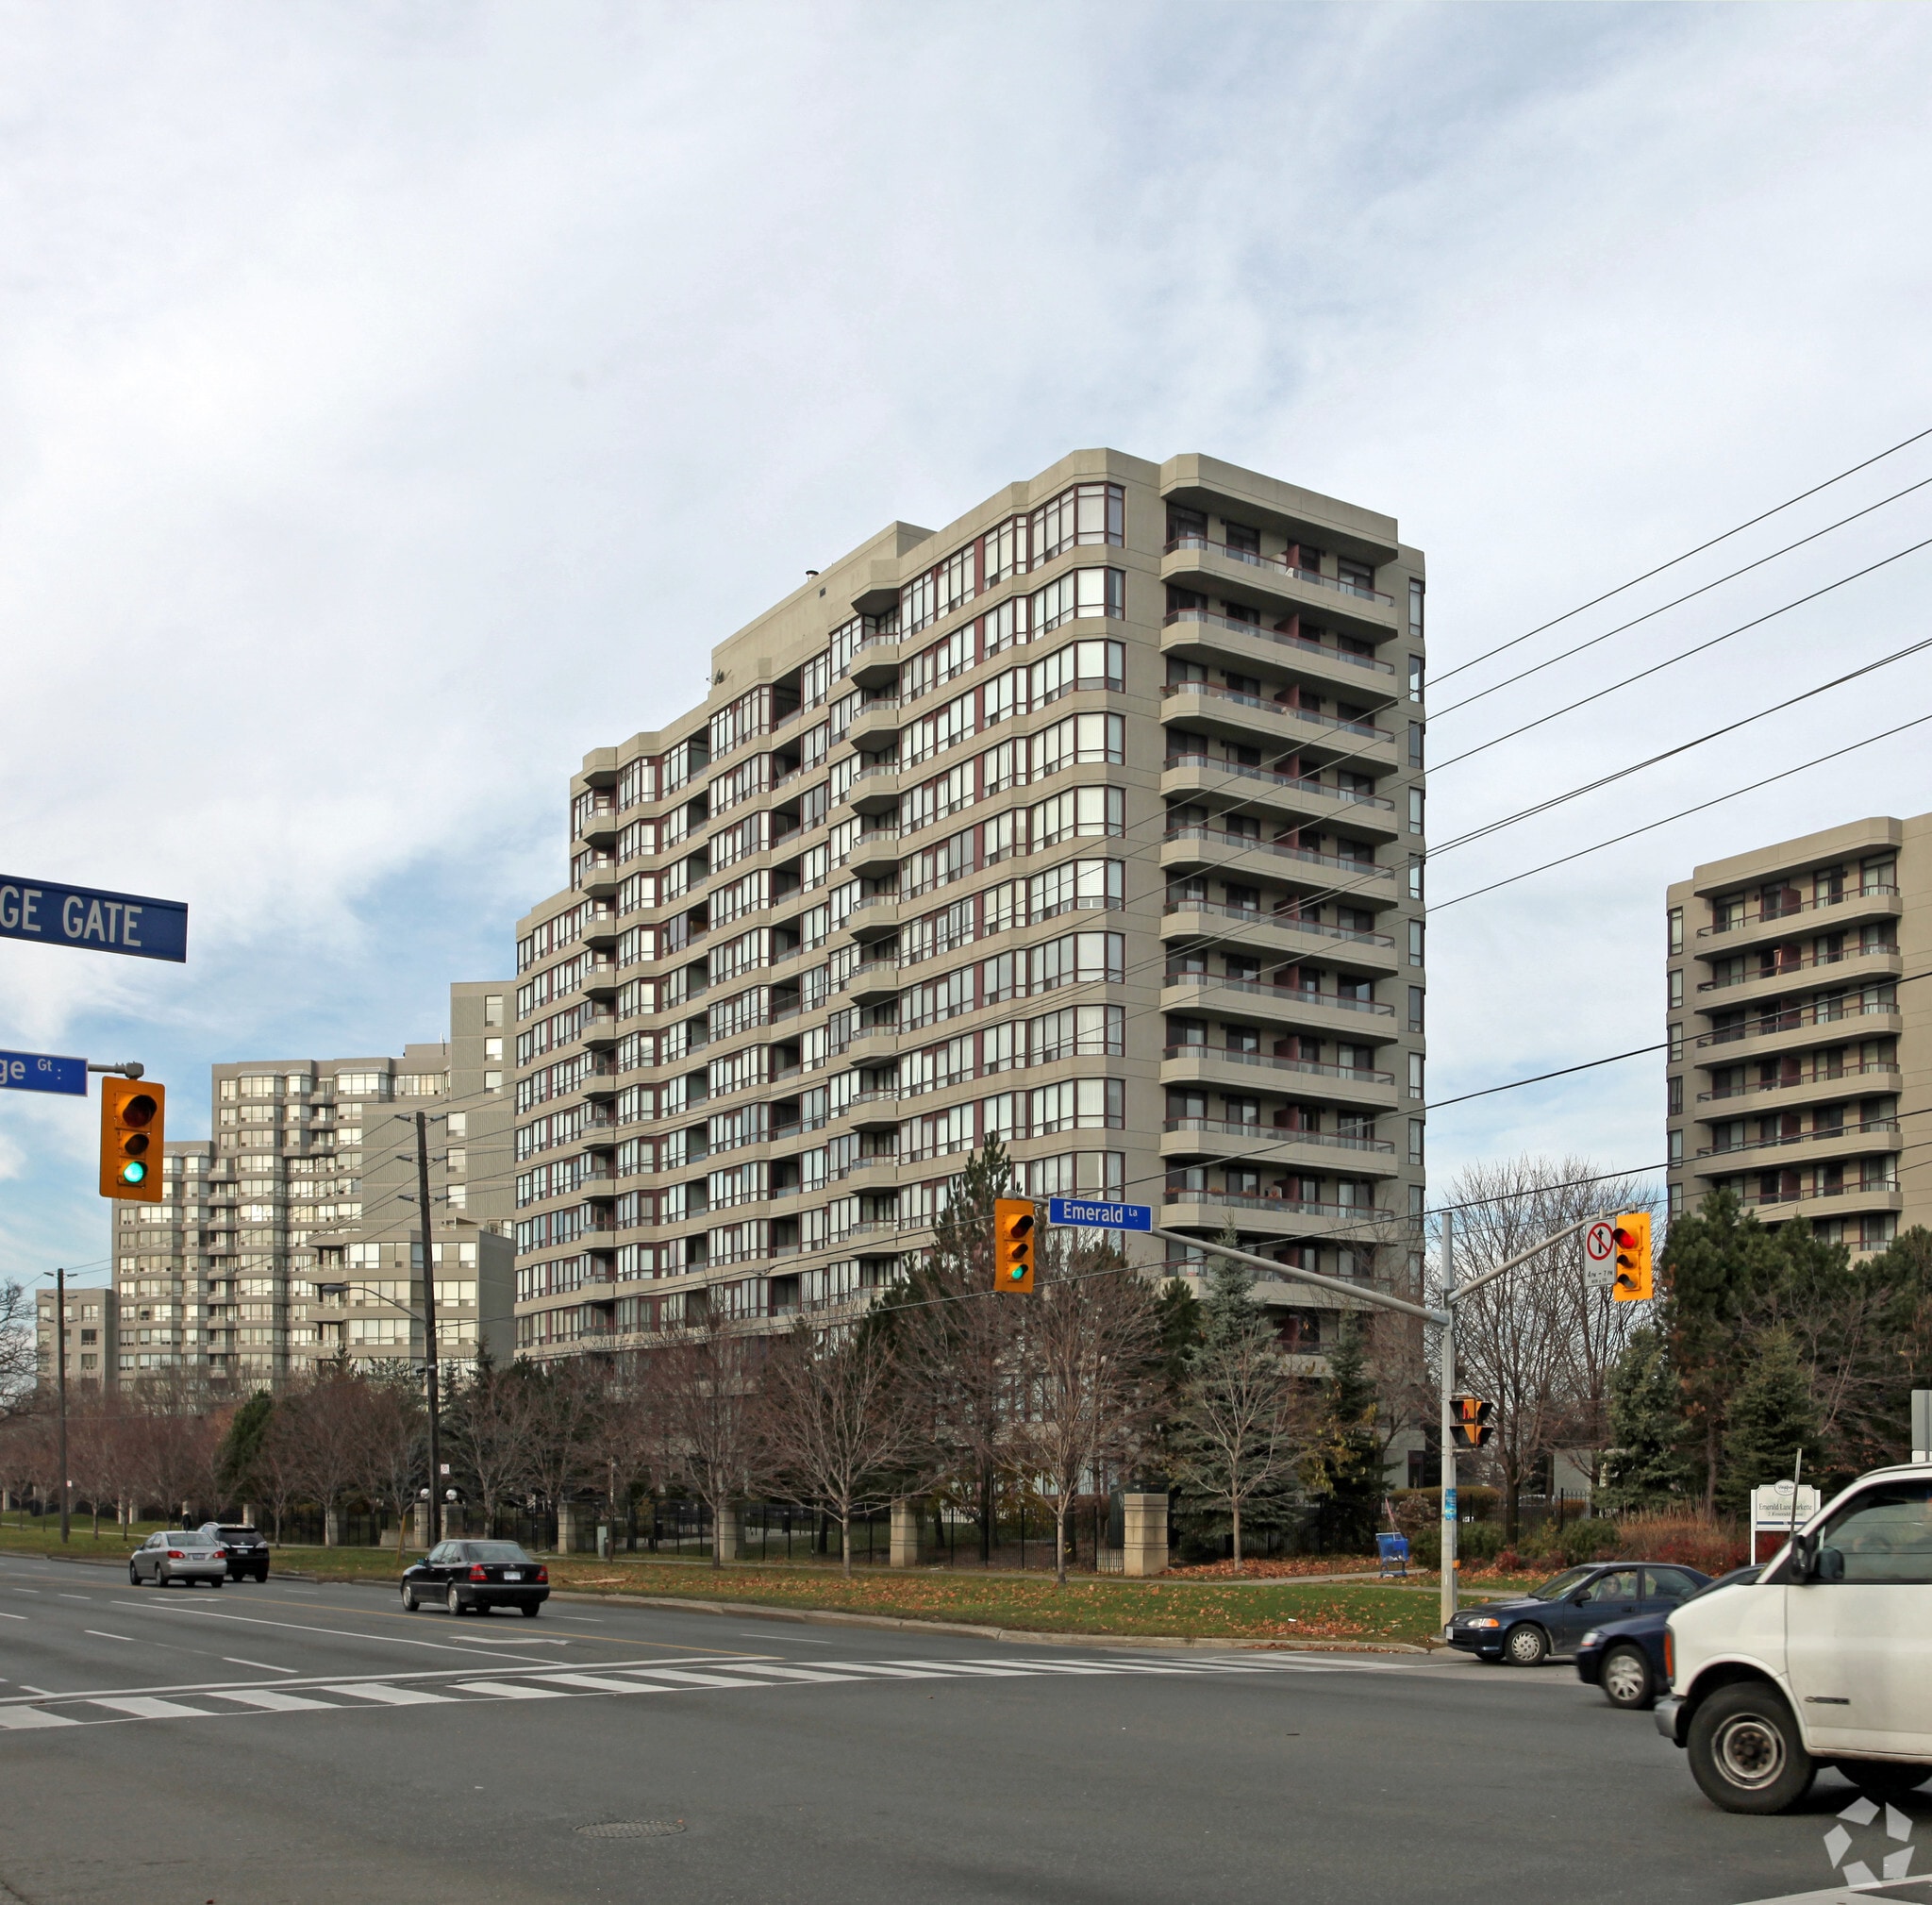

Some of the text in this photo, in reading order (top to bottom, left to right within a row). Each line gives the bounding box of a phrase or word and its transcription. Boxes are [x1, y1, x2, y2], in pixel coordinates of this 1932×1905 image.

[0, 885, 142, 947] GE GATE
[38, 1058, 53, 1072] Gt
[1063, 1201, 1138, 1224] Emerald La
